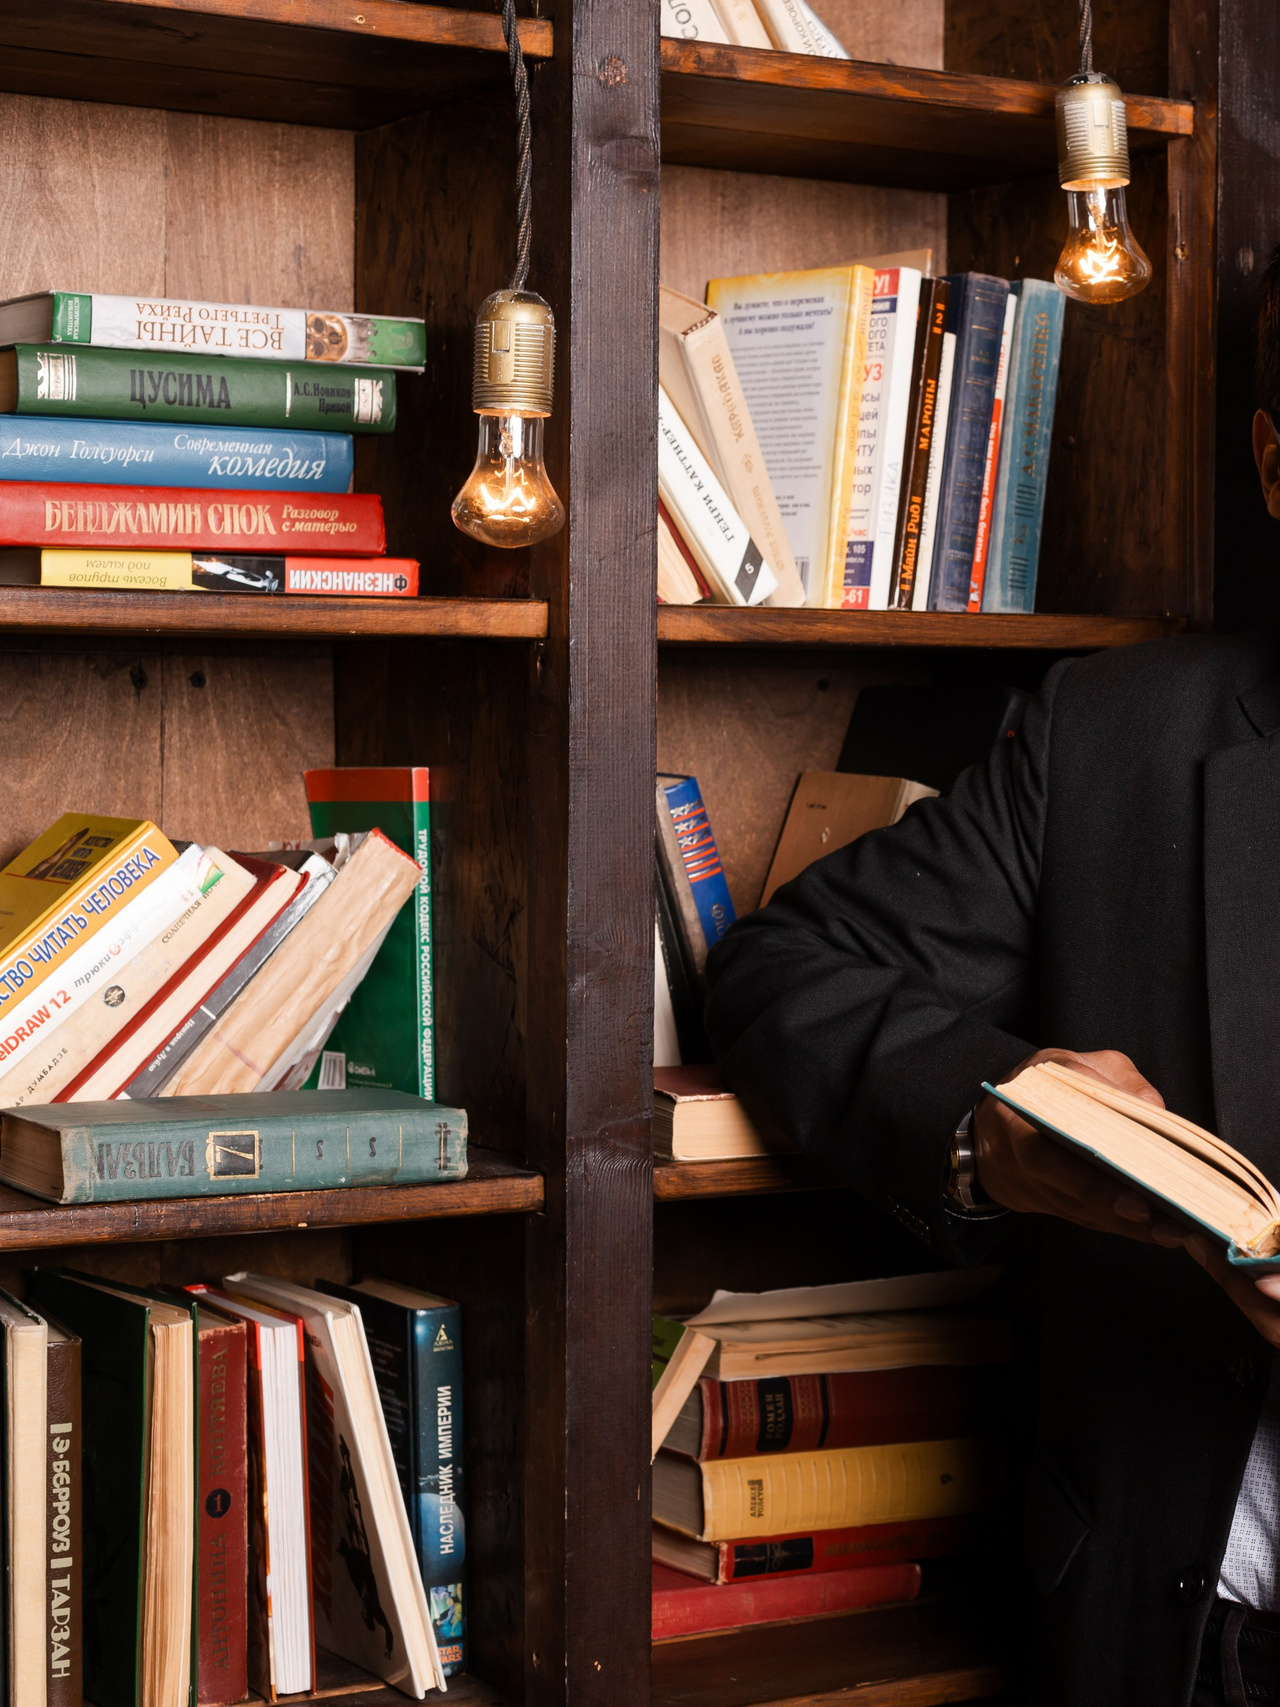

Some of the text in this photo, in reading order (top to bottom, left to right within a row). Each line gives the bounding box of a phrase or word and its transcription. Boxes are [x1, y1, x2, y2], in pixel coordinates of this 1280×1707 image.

[136, 320, 283, 351] ВСЕ ТАЙНЫ
[129, 369, 231, 410] ЦУСИМА
[918, 378, 937, 451] МАРОНЫ
[2, 437, 155, 467] Джон Голсуорси
[174, 433, 273, 456] Современная
[207, 447, 327, 481] комедия
[44, 499, 277, 536] БЕНДЖАМИН СПОК
[281, 505, 340, 524] Разговор
[703, 493, 735, 542] ГЕНРИ
[878, 461, 899, 541] ФИЗИКА
[902, 504, 922, 582] Майн Рид
[972, 520, 988, 563] богатым
[68, 570, 167, 587] Восемь трупов
[86, 559, 151, 572] под килем
[744, 562, 754, 574] 5
[28, 913, 88, 966] ЧИТАТЬ
[81, 846, 162, 918] ЧЕЛОВЕКА
[161, 899, 202, 945] СОЛНЕЧНАЯ
[50, 988, 72, 1013] 12
[73, 950, 114, 989] трюки
[417, 828, 435, 1101] ТРУДОВОЙ КОДЕКС РОССИЙСКОЙ ФЕДЕРАЦИИ
[168, 1016, 195, 1049] Призрак
[26, 1046, 69, 1095] ДУМБАДЗЕ
[210, 1348, 228, 1480] КОПТЯЕВА
[437, 1385, 455, 1555] НАСЛЕДНИК ИМПЕРИИ
[212, 1492, 224, 1514] 1
[210, 1532, 231, 1671] АНТОНИНА
[51, 1576, 72, 1678] ТАРЗАН
